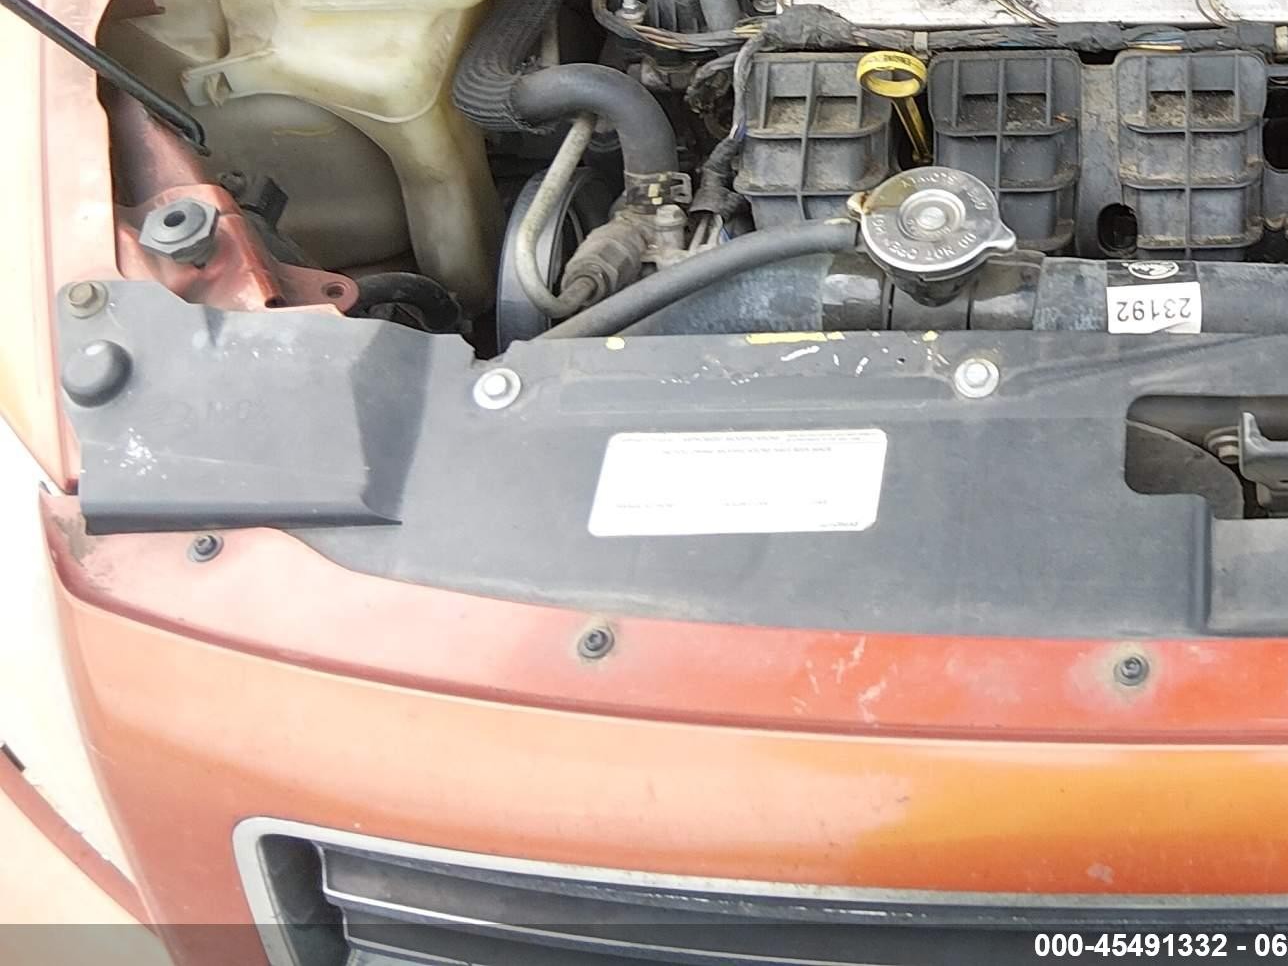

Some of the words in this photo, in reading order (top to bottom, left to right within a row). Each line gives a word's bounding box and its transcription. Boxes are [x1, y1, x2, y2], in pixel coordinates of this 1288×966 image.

[958, 233, 977, 249] DO
[924, 245, 956, 260] NOT
[1116, 297, 1192, 322] 23192
